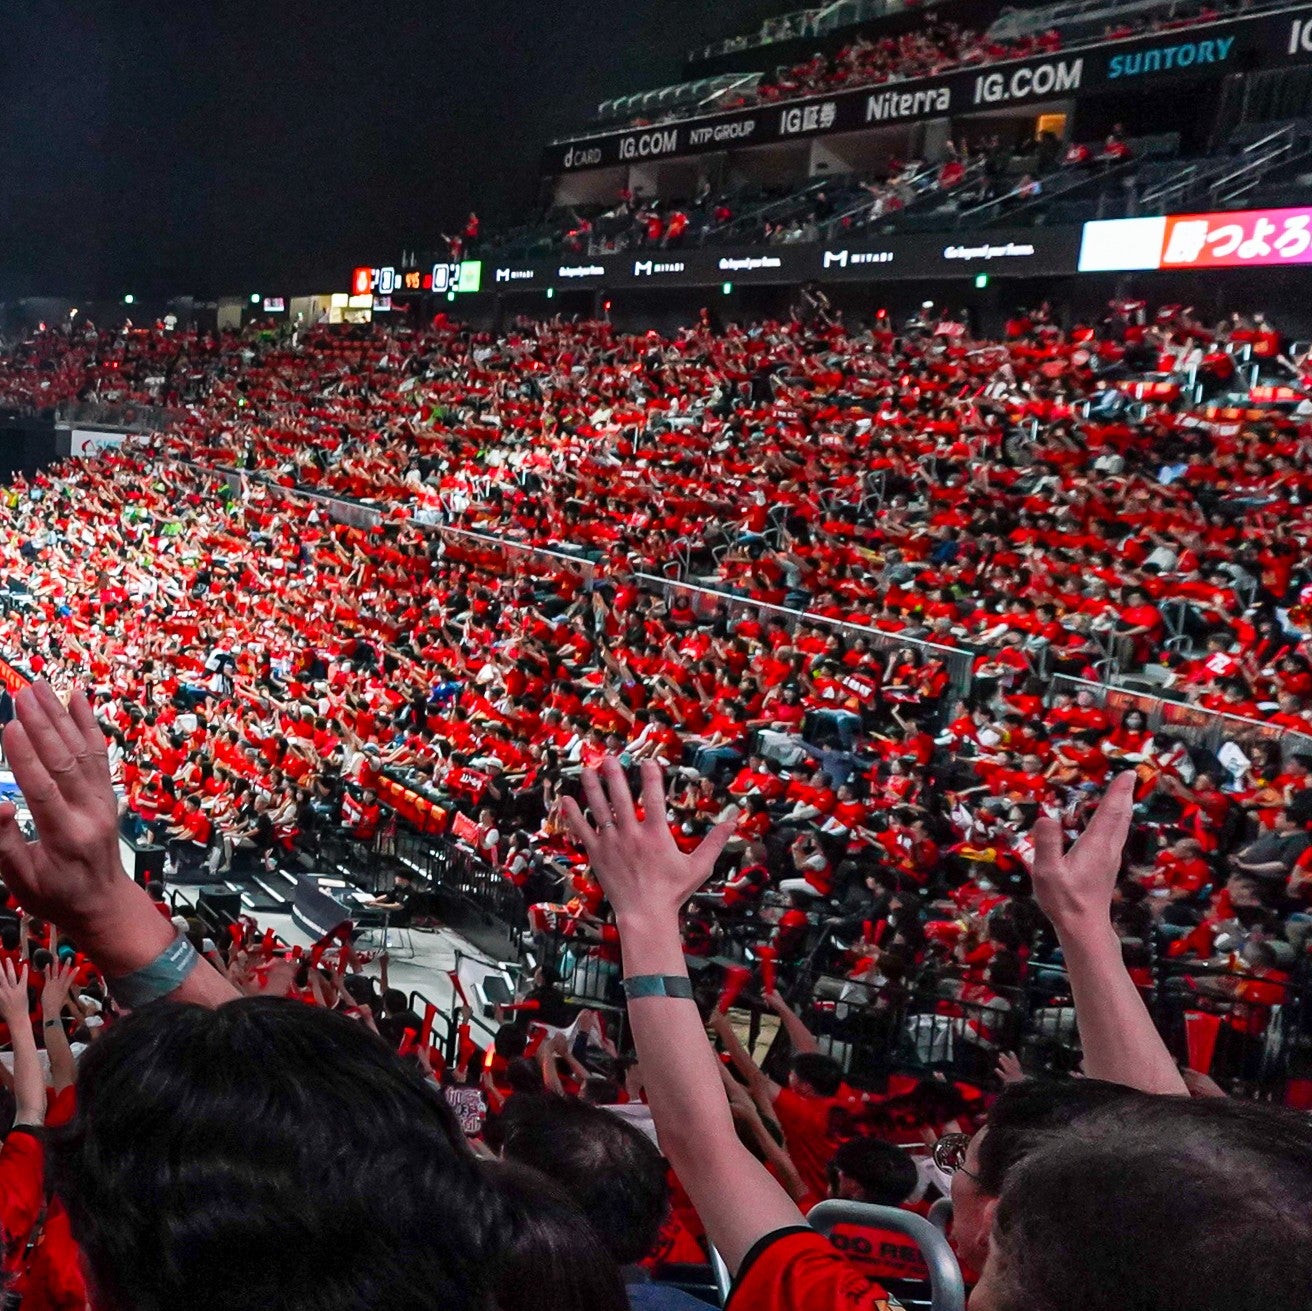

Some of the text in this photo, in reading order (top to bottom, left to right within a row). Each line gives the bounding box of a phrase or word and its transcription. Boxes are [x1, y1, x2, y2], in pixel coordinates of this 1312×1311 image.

[1107, 35, 1236, 79] SUNTORY
[974, 57, 1084, 104] IG.COM
[865, 87, 951, 122] Niterra
[619, 129, 678, 161] IG.COM
[689, 119, 756, 145] NTP GROUP
[574, 147, 602, 166] CARD
[1163, 214, 1312, 263] つよろ
